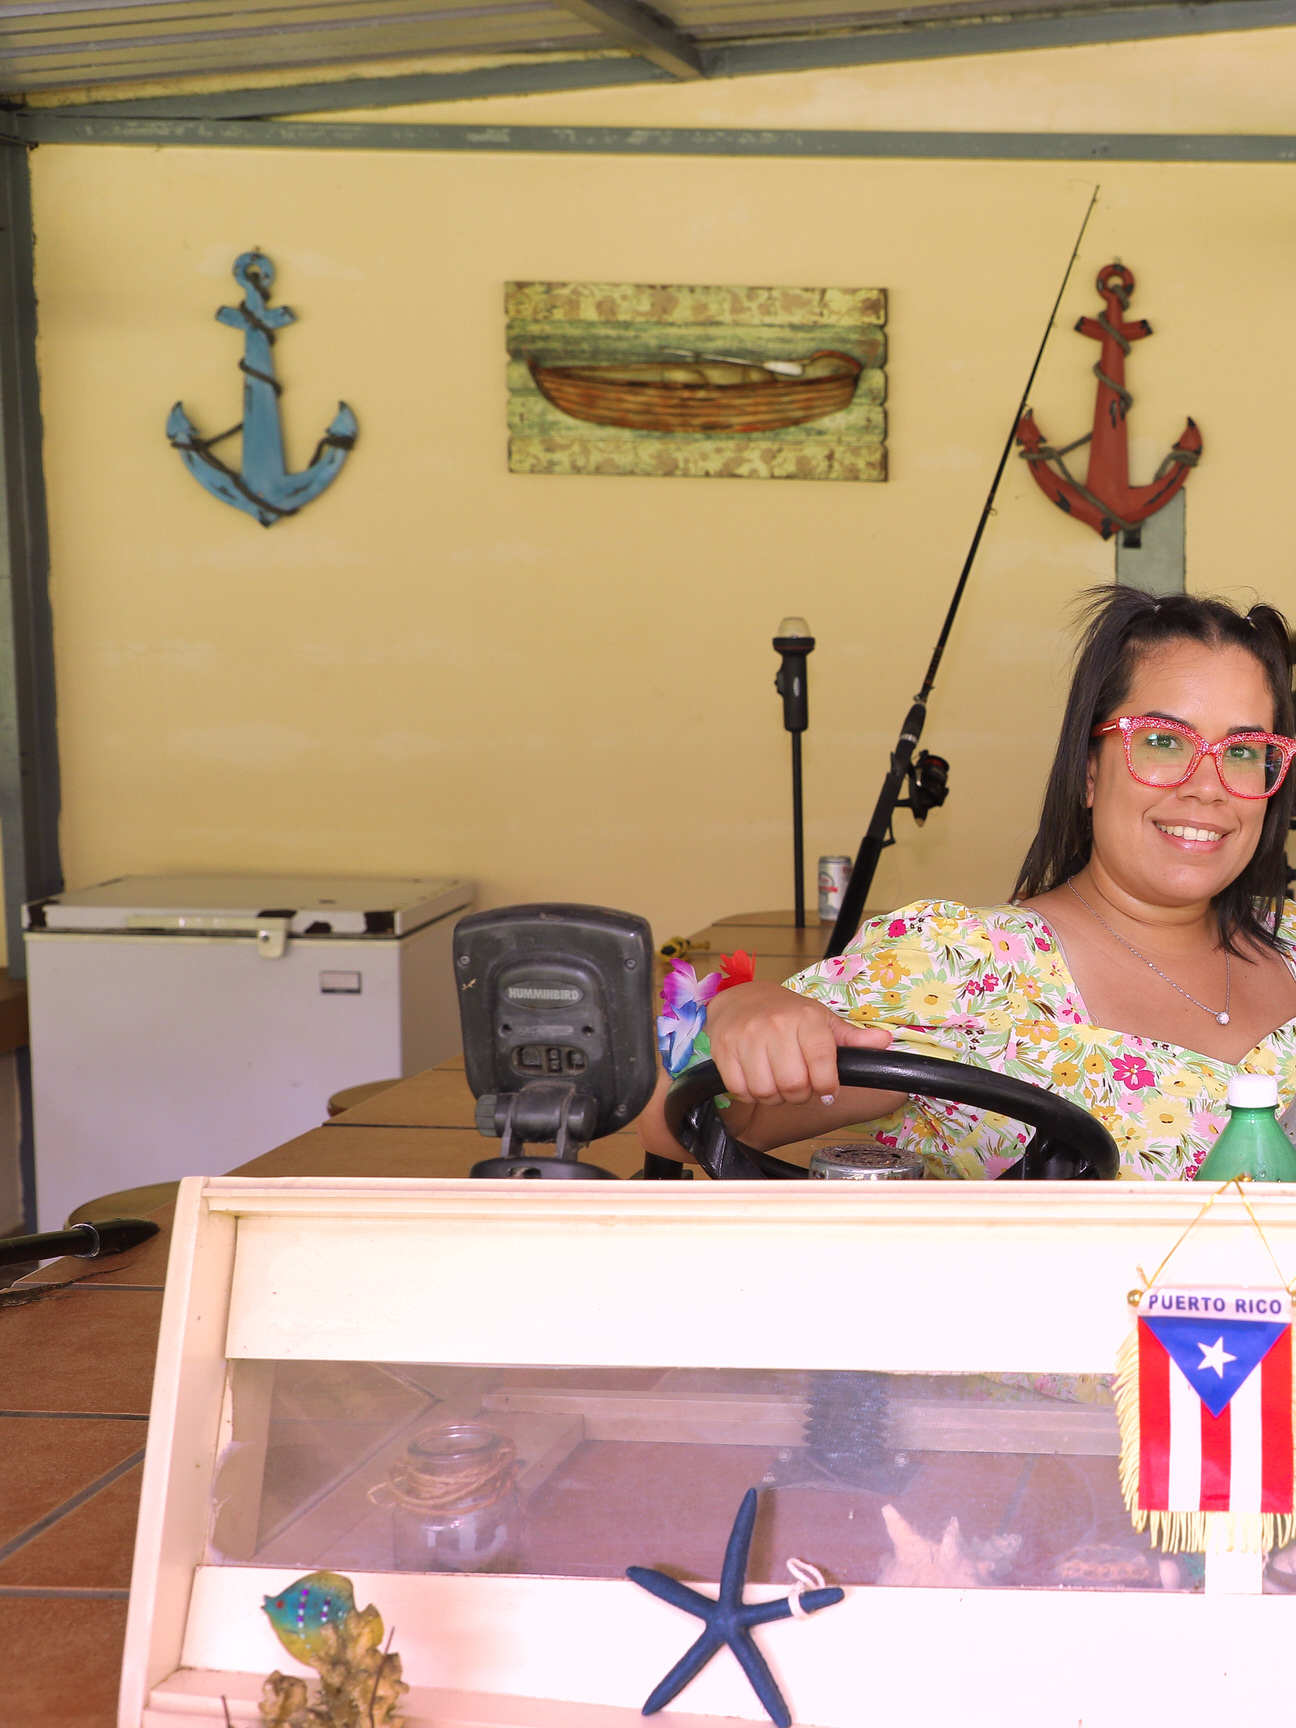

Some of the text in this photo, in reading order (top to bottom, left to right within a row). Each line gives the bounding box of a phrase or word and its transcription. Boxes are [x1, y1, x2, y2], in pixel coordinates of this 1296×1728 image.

[508, 987, 580, 1001] HUMMINBIRD
[1148, 1294, 1282, 1315] PUERTO RICO
